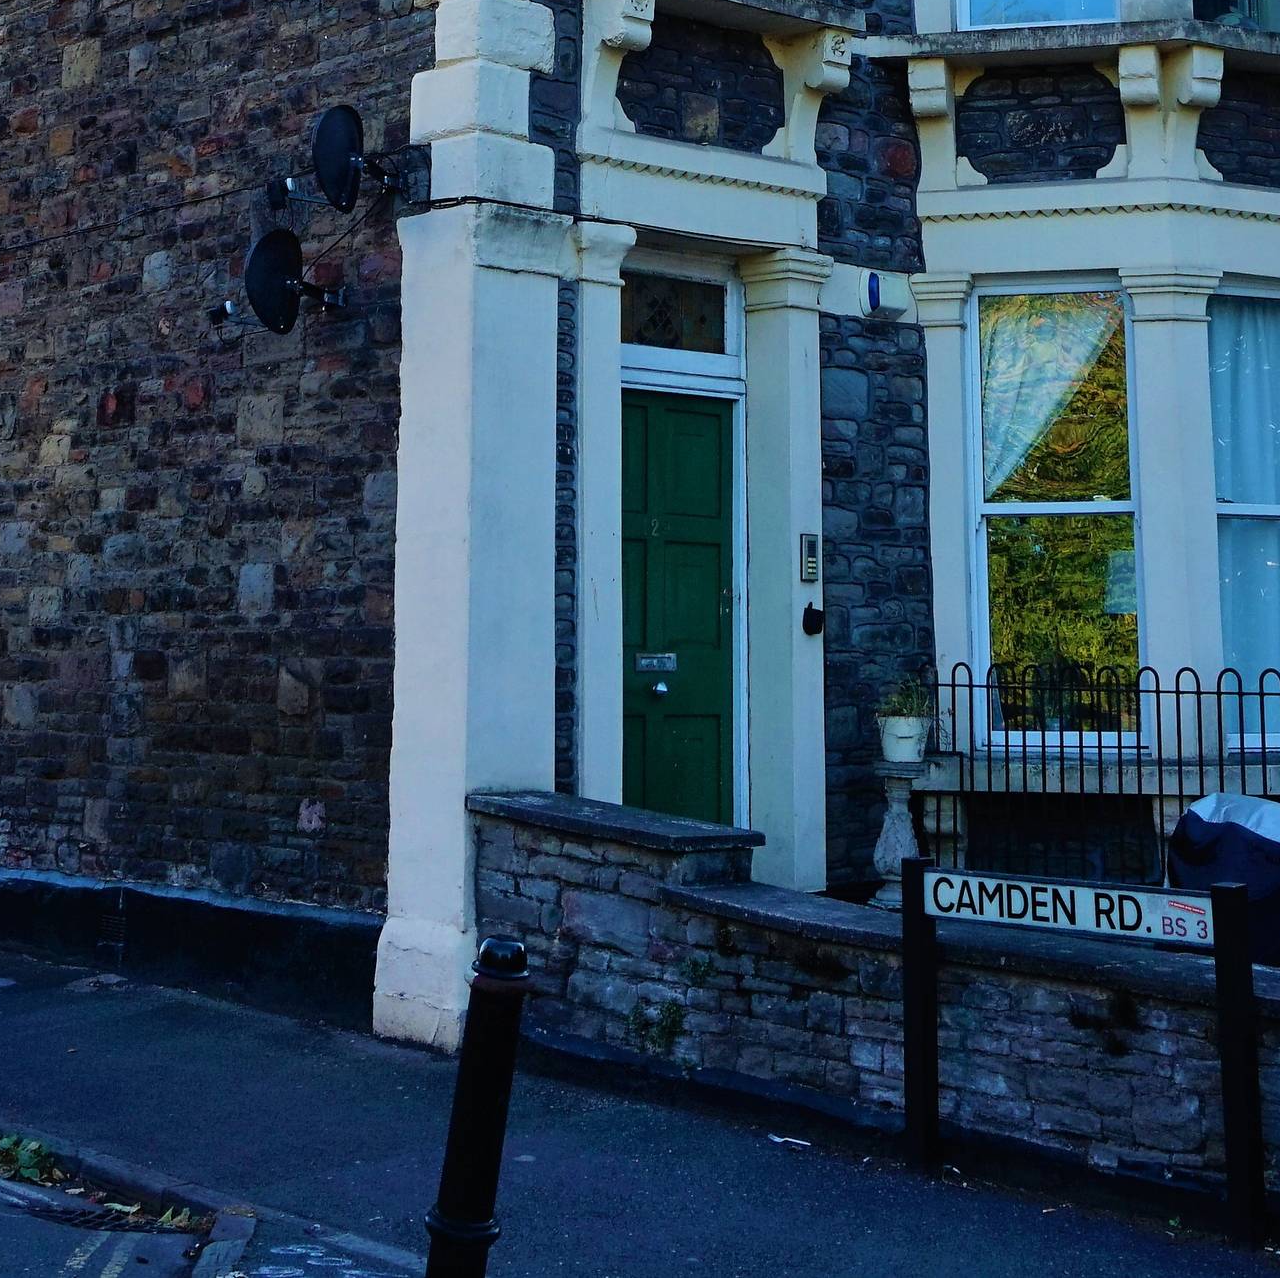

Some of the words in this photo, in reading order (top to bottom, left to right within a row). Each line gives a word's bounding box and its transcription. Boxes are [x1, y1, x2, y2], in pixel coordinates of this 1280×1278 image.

[933, 876, 1076, 926] CAMDEN
[1094, 892, 1152, 934] RD.
[1162, 916, 1187, 937] BS
[1197, 919, 1208, 940] 3
